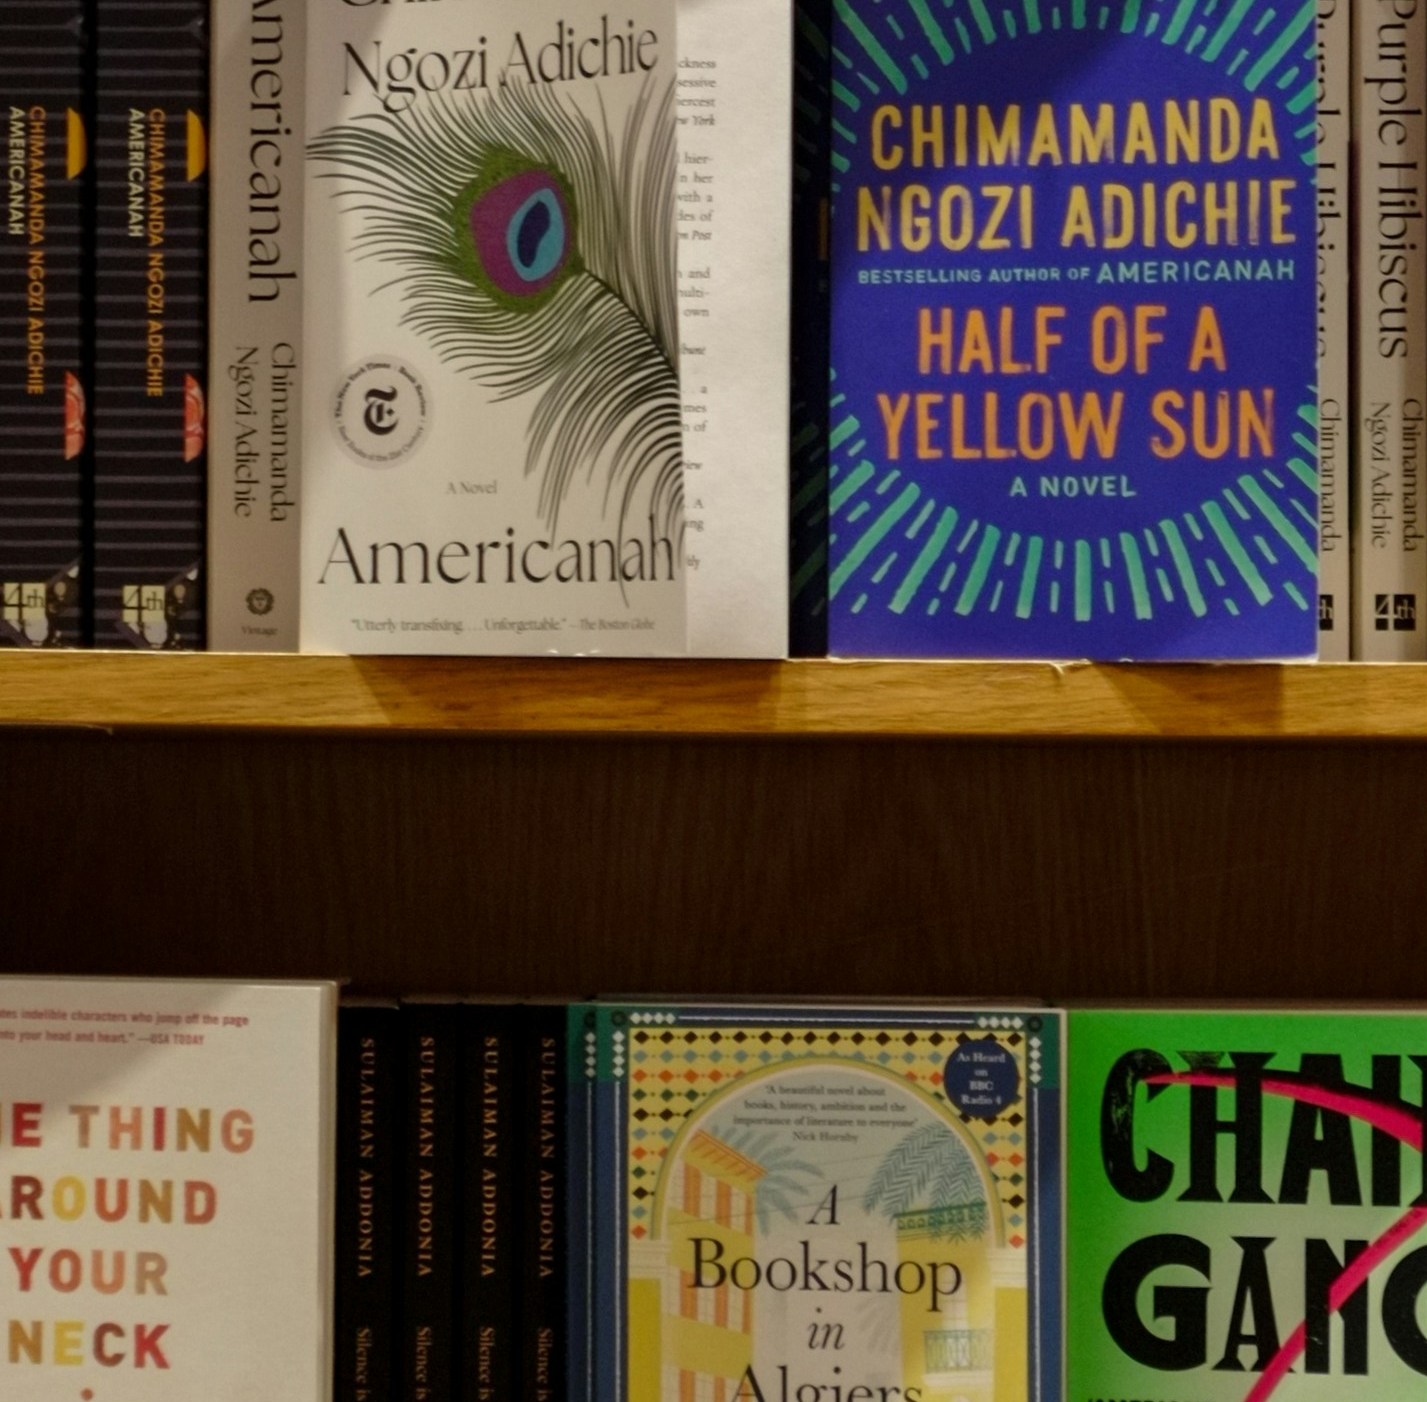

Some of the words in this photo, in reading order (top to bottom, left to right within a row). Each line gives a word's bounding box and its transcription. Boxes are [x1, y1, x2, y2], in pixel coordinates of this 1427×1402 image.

[342, 37, 488, 114] Ngozi
[501, 15, 660, 88] Adichie
[871, 98, 1281, 171] CHIMAMANDA
[128, 108, 144, 240] AMERICANAH
[150, 108, 166, 248] CHIMAMANDA
[857, 184, 1036, 253] NGOZI
[1061, 179, 1299, 252] ADICHIE
[149, 257, 165, 317] NGOZI
[858, 268, 984, 285] BESTSELLING
[988, 267, 1063, 284] AUTHOR
[1067, 266, 1093, 282] OF
[1096, 259, 1297, 284] AMERICANAH
[148, 322, 164, 400] ADICHIE
[919, 306, 1067, 375] HALF
[1091, 306, 1168, 375] OF
[1189, 305, 1227, 373] A
[876, 389, 1126, 460] YELLOW
[1151, 388, 1276, 460] SUN
[1010, 477, 1029, 497] A
[1041, 474, 1137, 497] NOVEL
[317, 514, 677, 585] Americanah
[69, 1104, 256, 1155] THING
[484, 1036, 499, 1159] SULAIMAN
[482, 1171, 497, 1280] ADDONIA
[808, 1186, 841, 1227] A
[8, 1248, 169, 1297] YOUR
[688, 1237, 962, 1313] Bookshop
[8, 1321, 171, 1371] NECK
[807, 1308, 847, 1351] in
